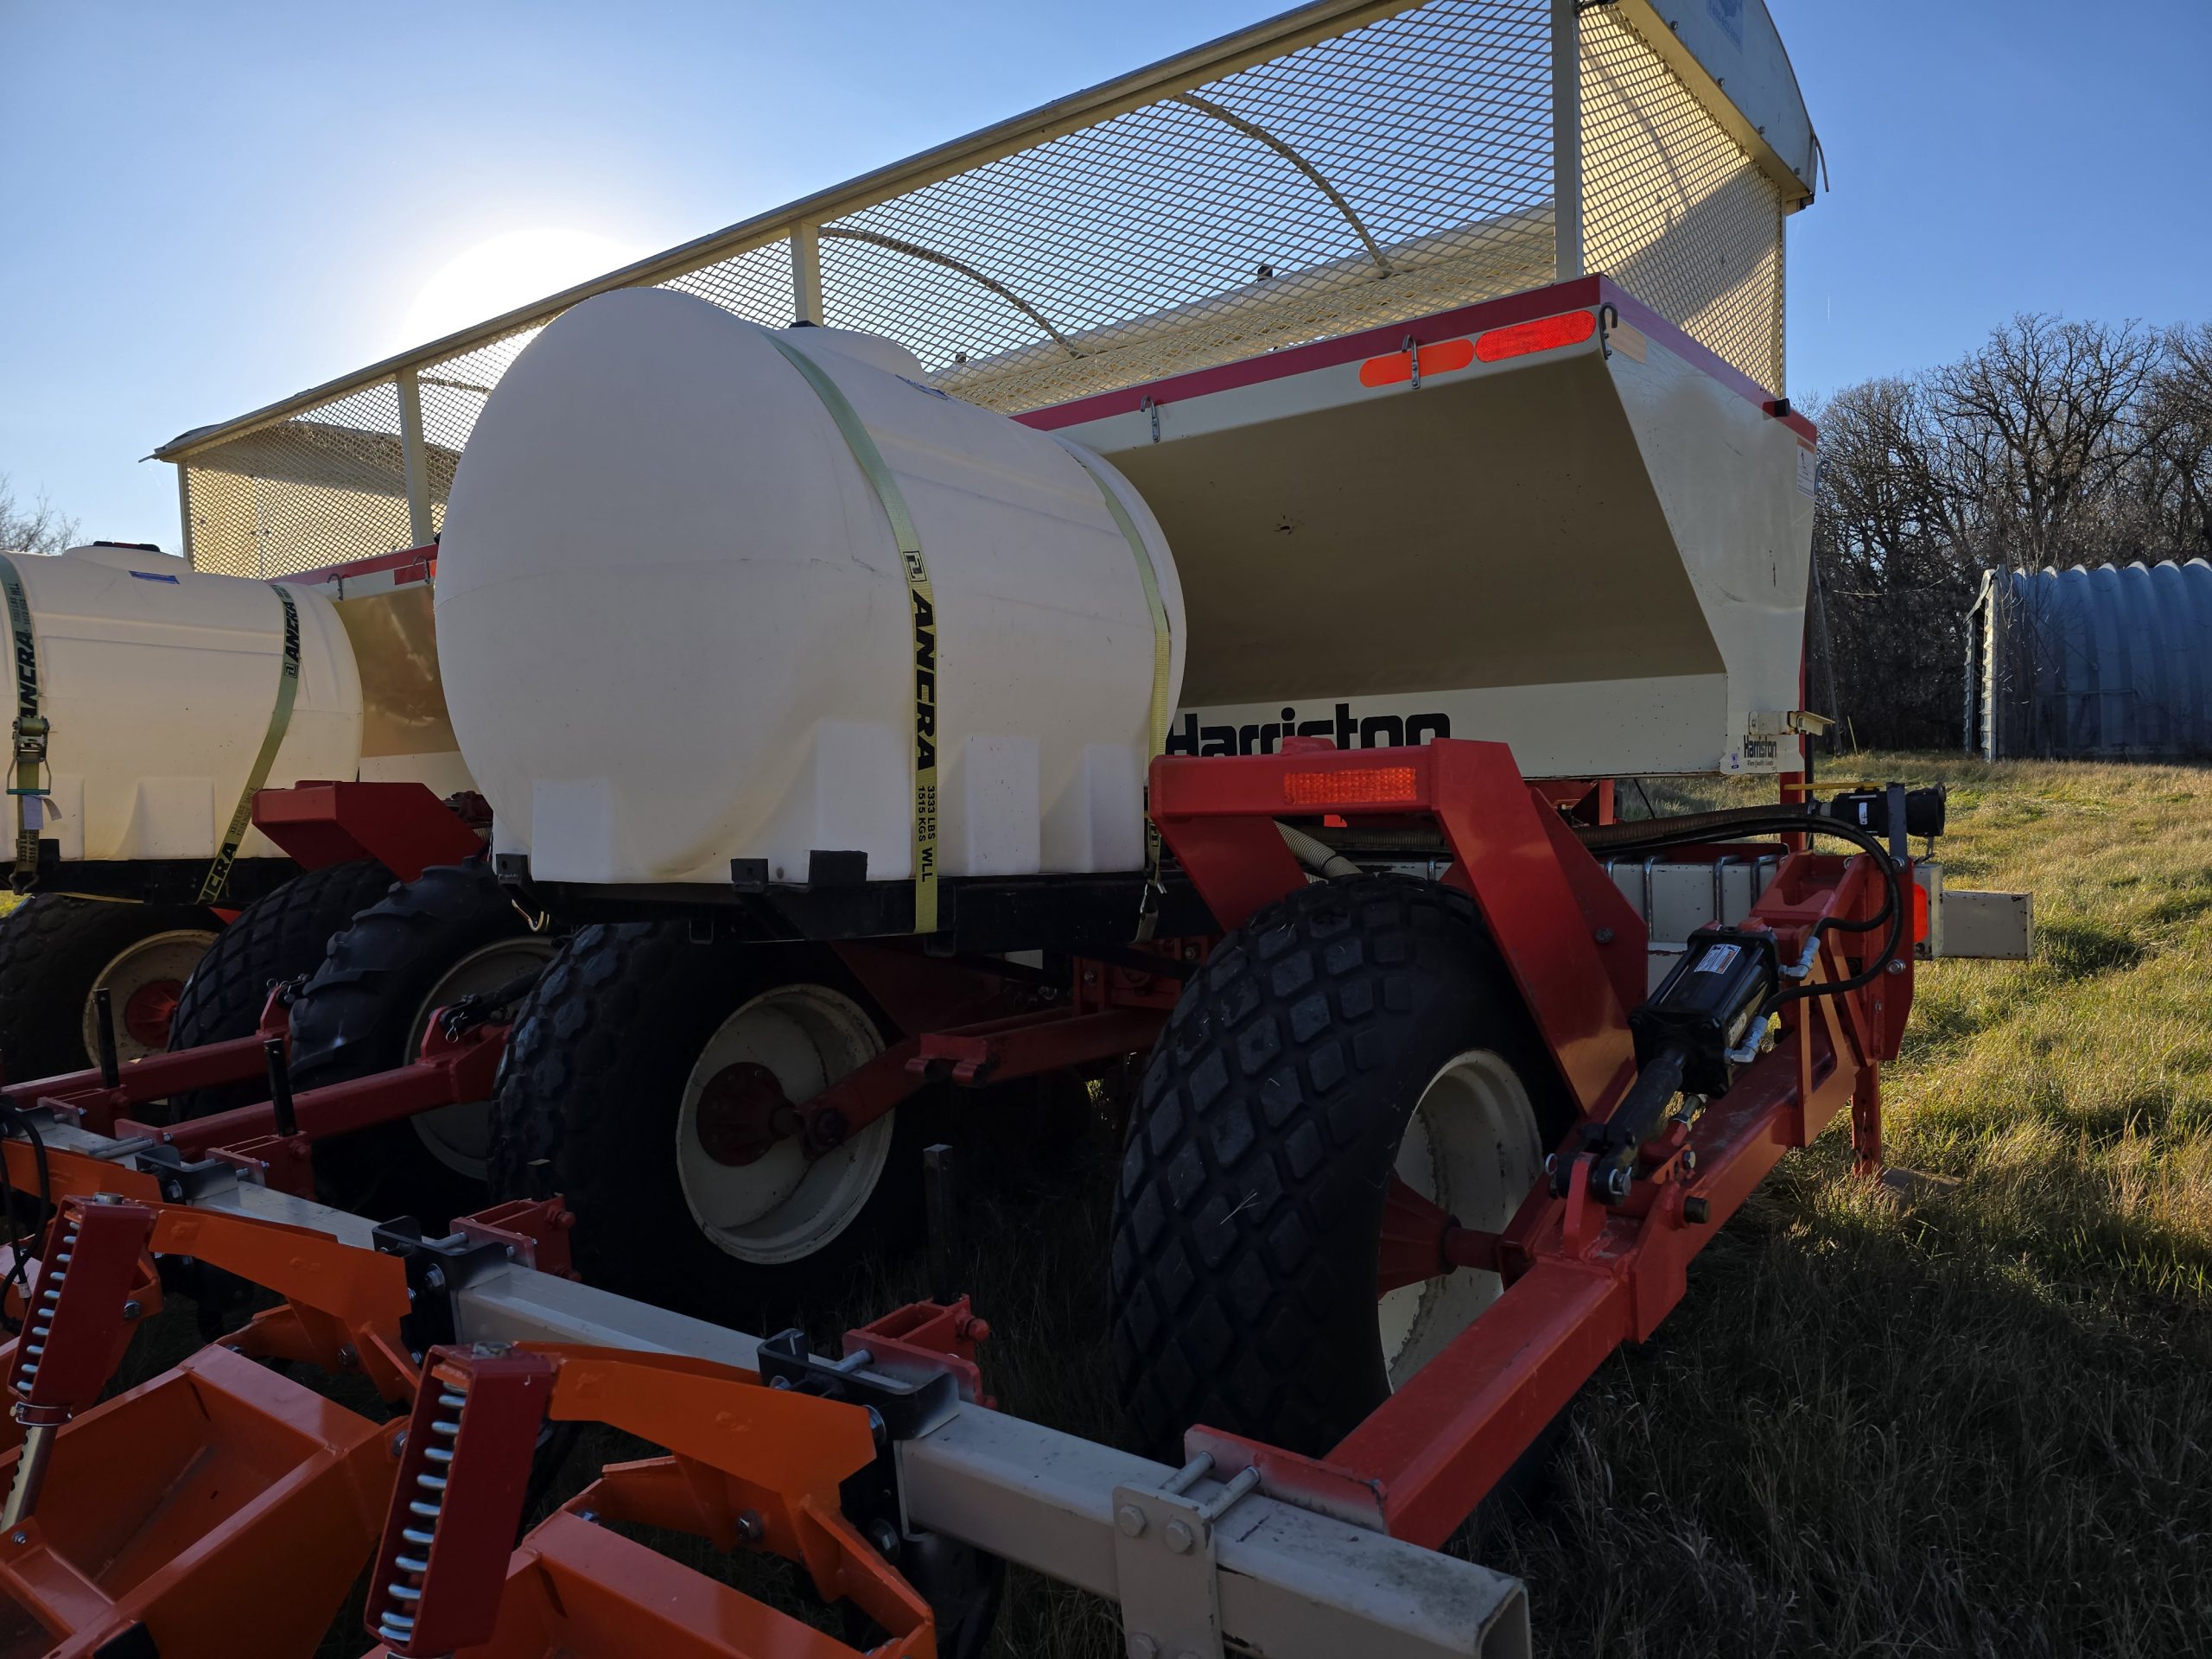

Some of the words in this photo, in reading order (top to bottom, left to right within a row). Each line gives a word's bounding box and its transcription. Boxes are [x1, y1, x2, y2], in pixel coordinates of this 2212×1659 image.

[283, 601, 300, 663] ANCRA
[16, 631, 37, 719] ANCRA
[912, 588, 936, 771] ANCRA
[918, 817, 926, 842] KGS
[927, 817, 936, 840] LBS
[921, 847, 933, 882] WLL
